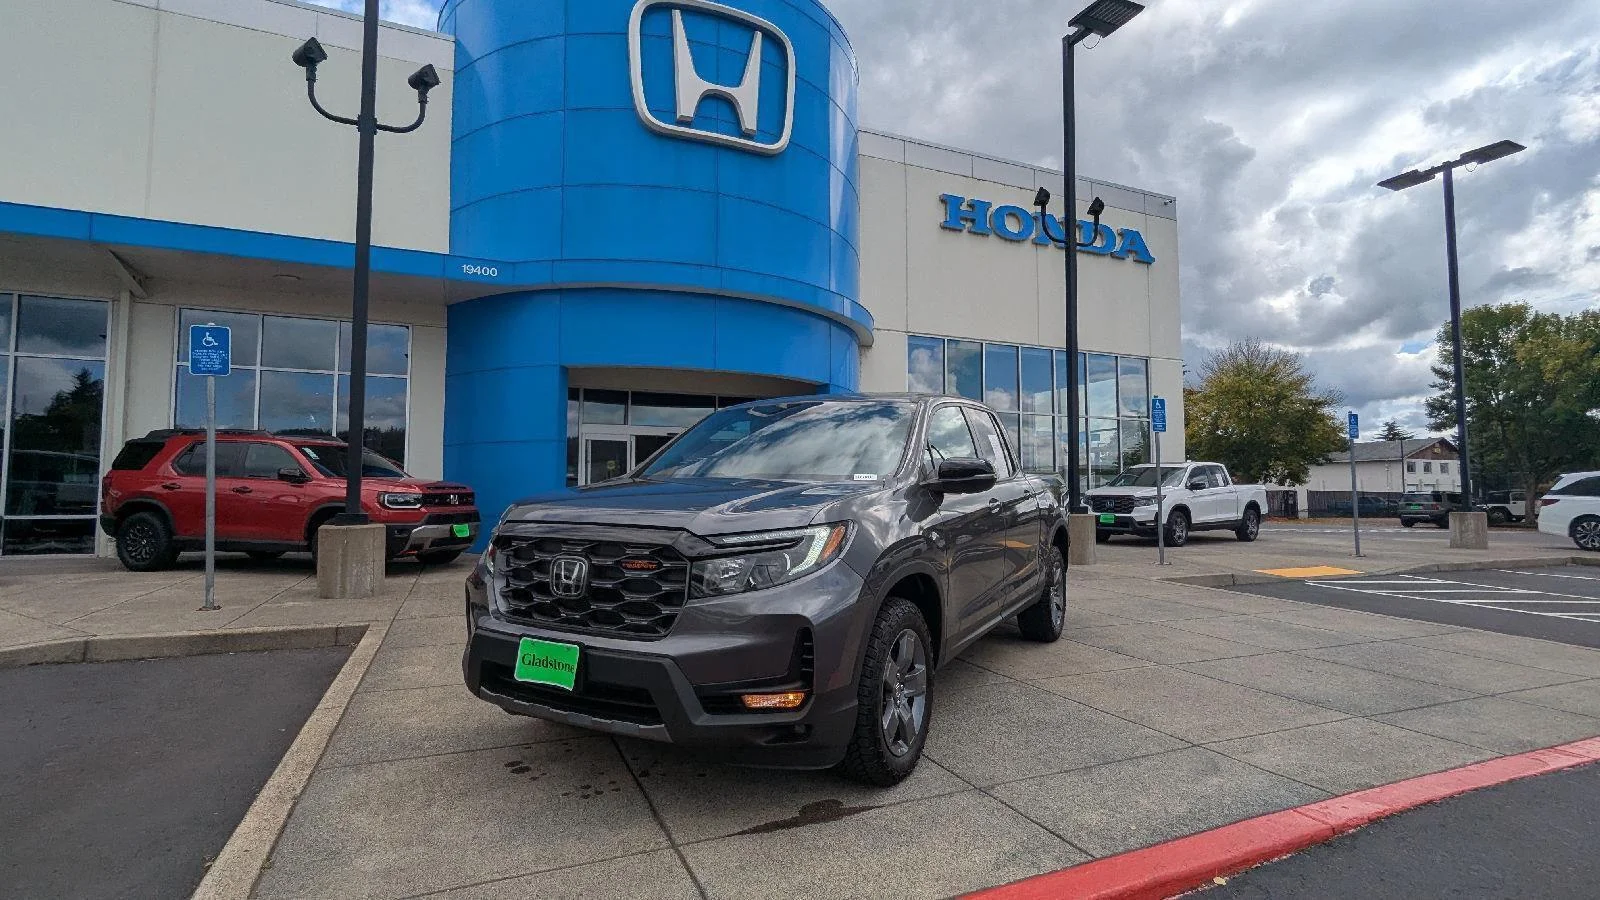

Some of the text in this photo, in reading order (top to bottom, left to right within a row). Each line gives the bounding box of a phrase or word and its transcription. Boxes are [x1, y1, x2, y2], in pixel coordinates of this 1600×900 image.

[940, 193, 1155, 264] HONDA
[461, 264, 498, 277] 19400
[521, 653, 575, 674] Gladstone
